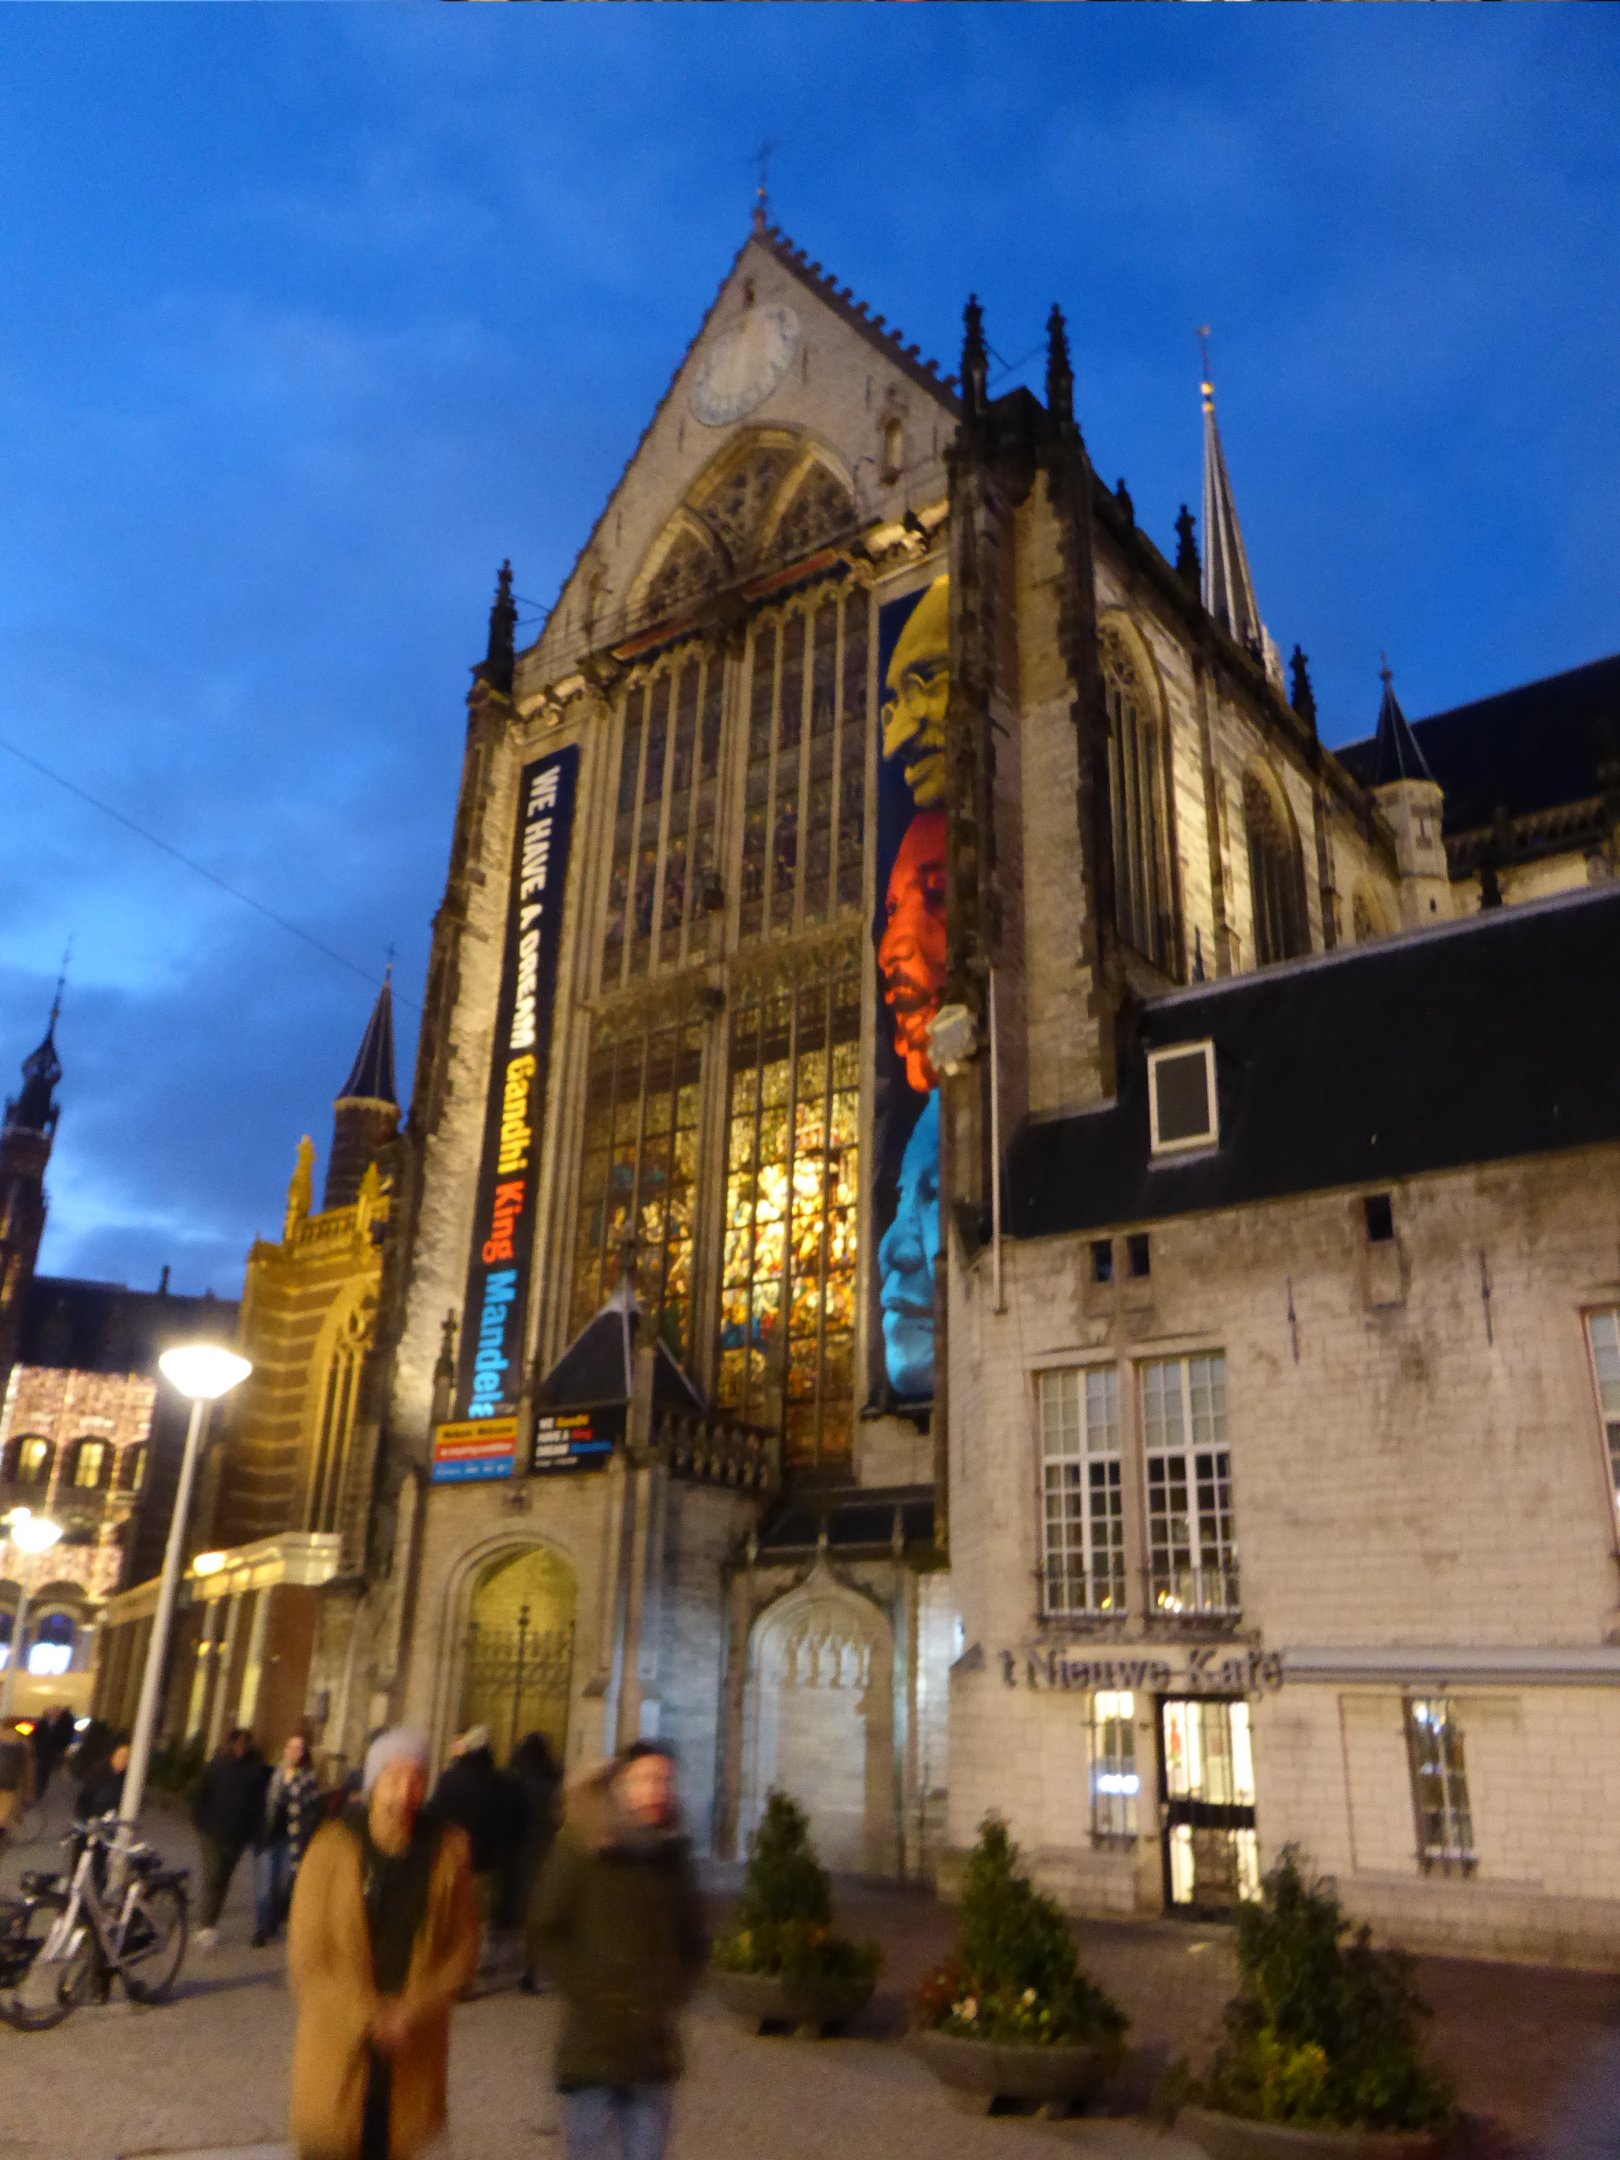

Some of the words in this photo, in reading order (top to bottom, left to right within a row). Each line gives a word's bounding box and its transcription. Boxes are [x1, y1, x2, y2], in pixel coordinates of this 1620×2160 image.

[527, 765, 560, 817] WE
[520, 818, 552, 900] HAVE
[520, 903, 543, 931] A
[510, 929, 541, 1049] DREAM
[497, 1054, 537, 1175] Gandhi
[482, 1180, 527, 1264] King
